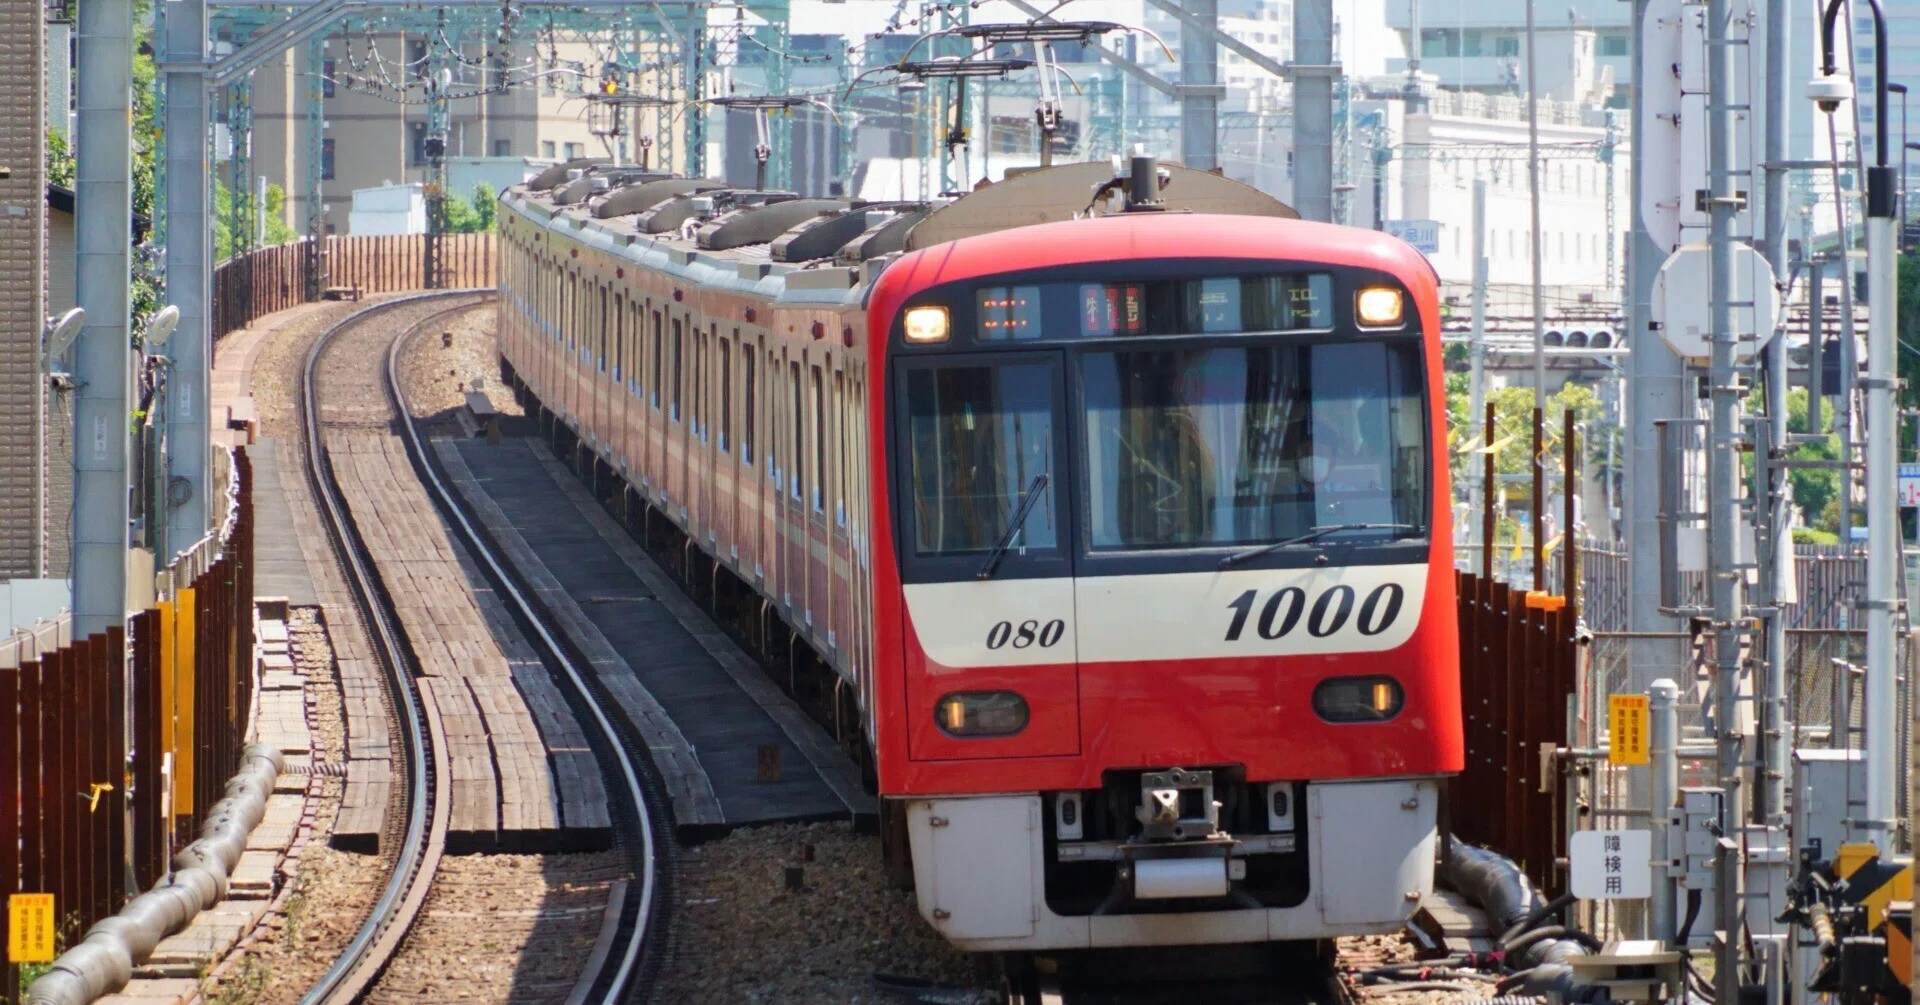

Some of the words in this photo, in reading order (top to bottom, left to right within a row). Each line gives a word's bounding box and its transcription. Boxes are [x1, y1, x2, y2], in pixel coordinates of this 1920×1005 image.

[986, 619, 1065, 650] 080
[1225, 583, 1404, 641] 1000
[1604, 835, 1621, 894] 障検用
